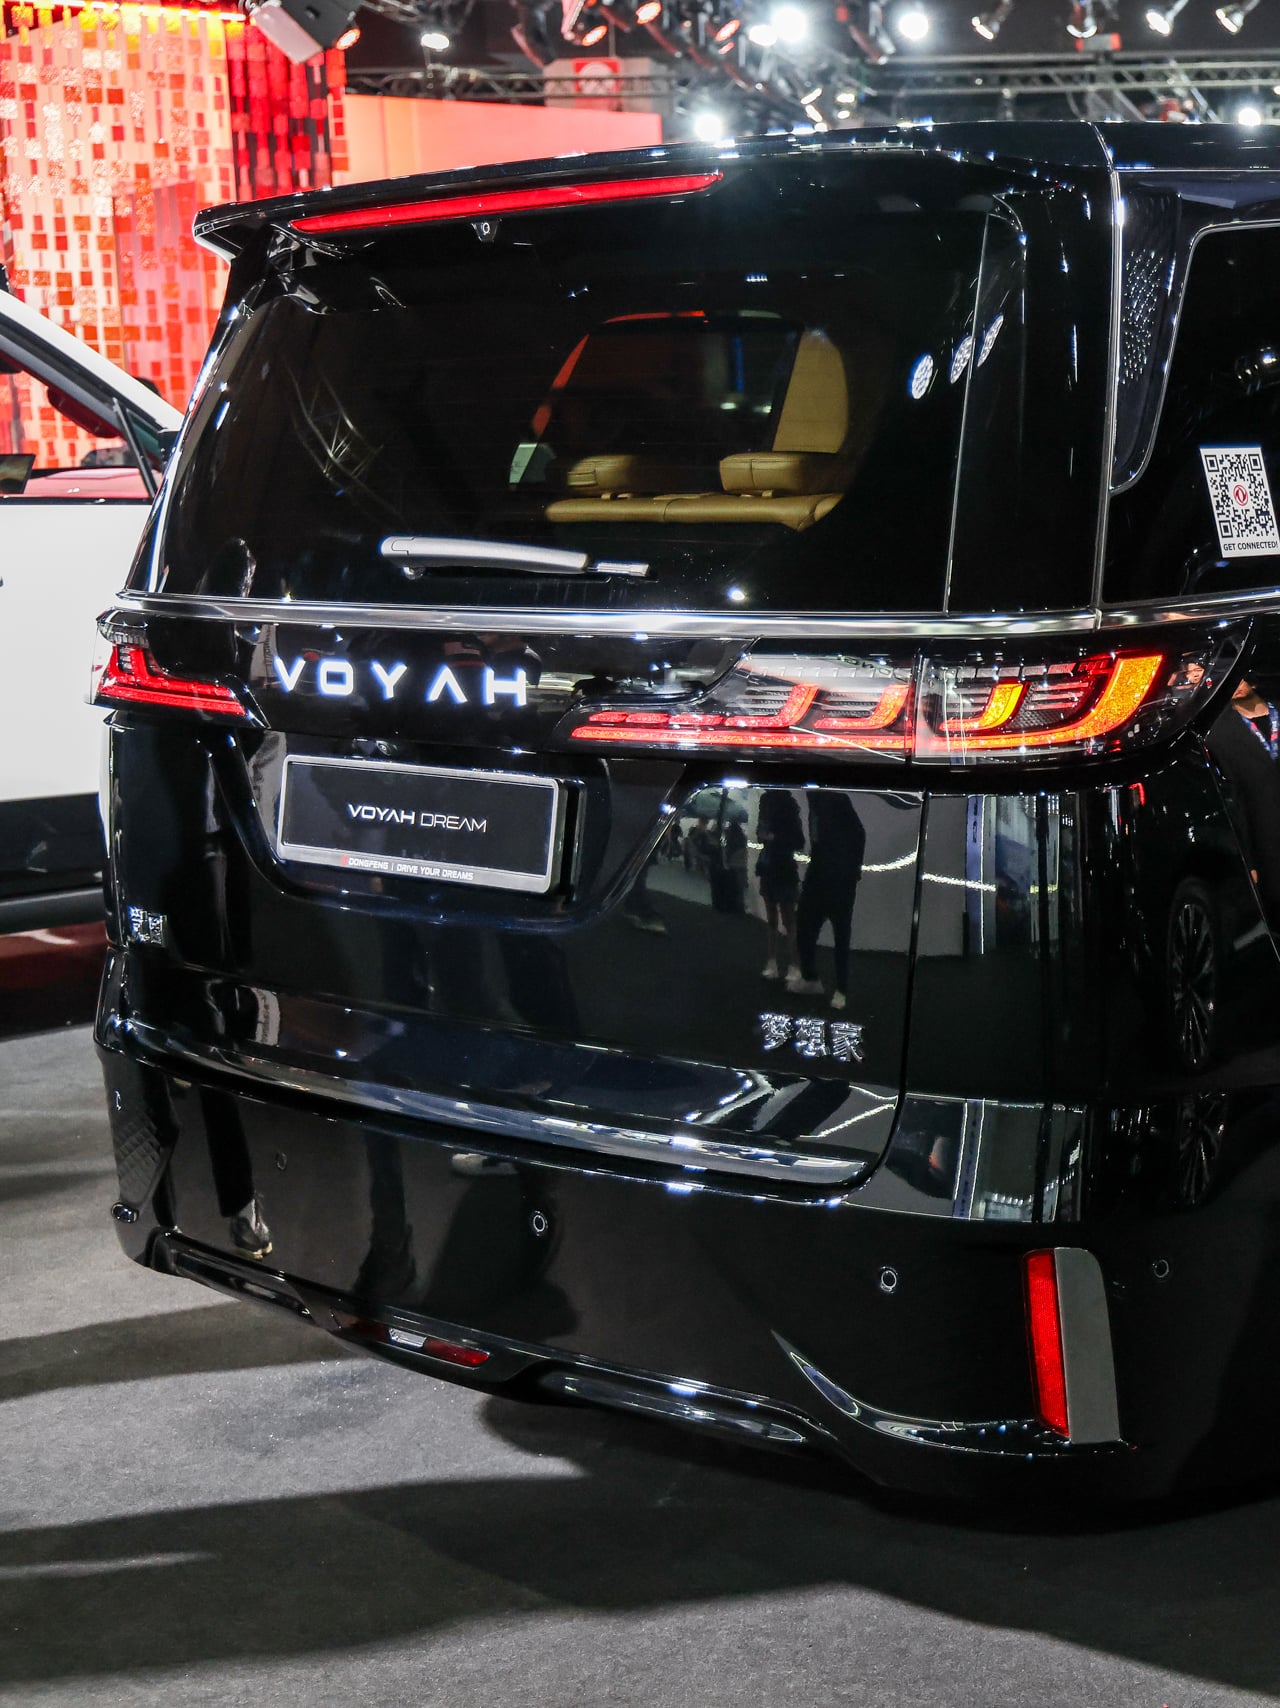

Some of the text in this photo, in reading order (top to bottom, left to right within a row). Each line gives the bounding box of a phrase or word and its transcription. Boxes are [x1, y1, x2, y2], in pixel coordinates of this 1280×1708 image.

[1223, 541, 1278, 551] GET CONNECTED!
[274, 655, 527, 707] VOYAH
[348, 803, 487, 833] VOYAH DREAM
[349, 857, 474, 881] DONGFENG DRIVE YOUR DREAMS
